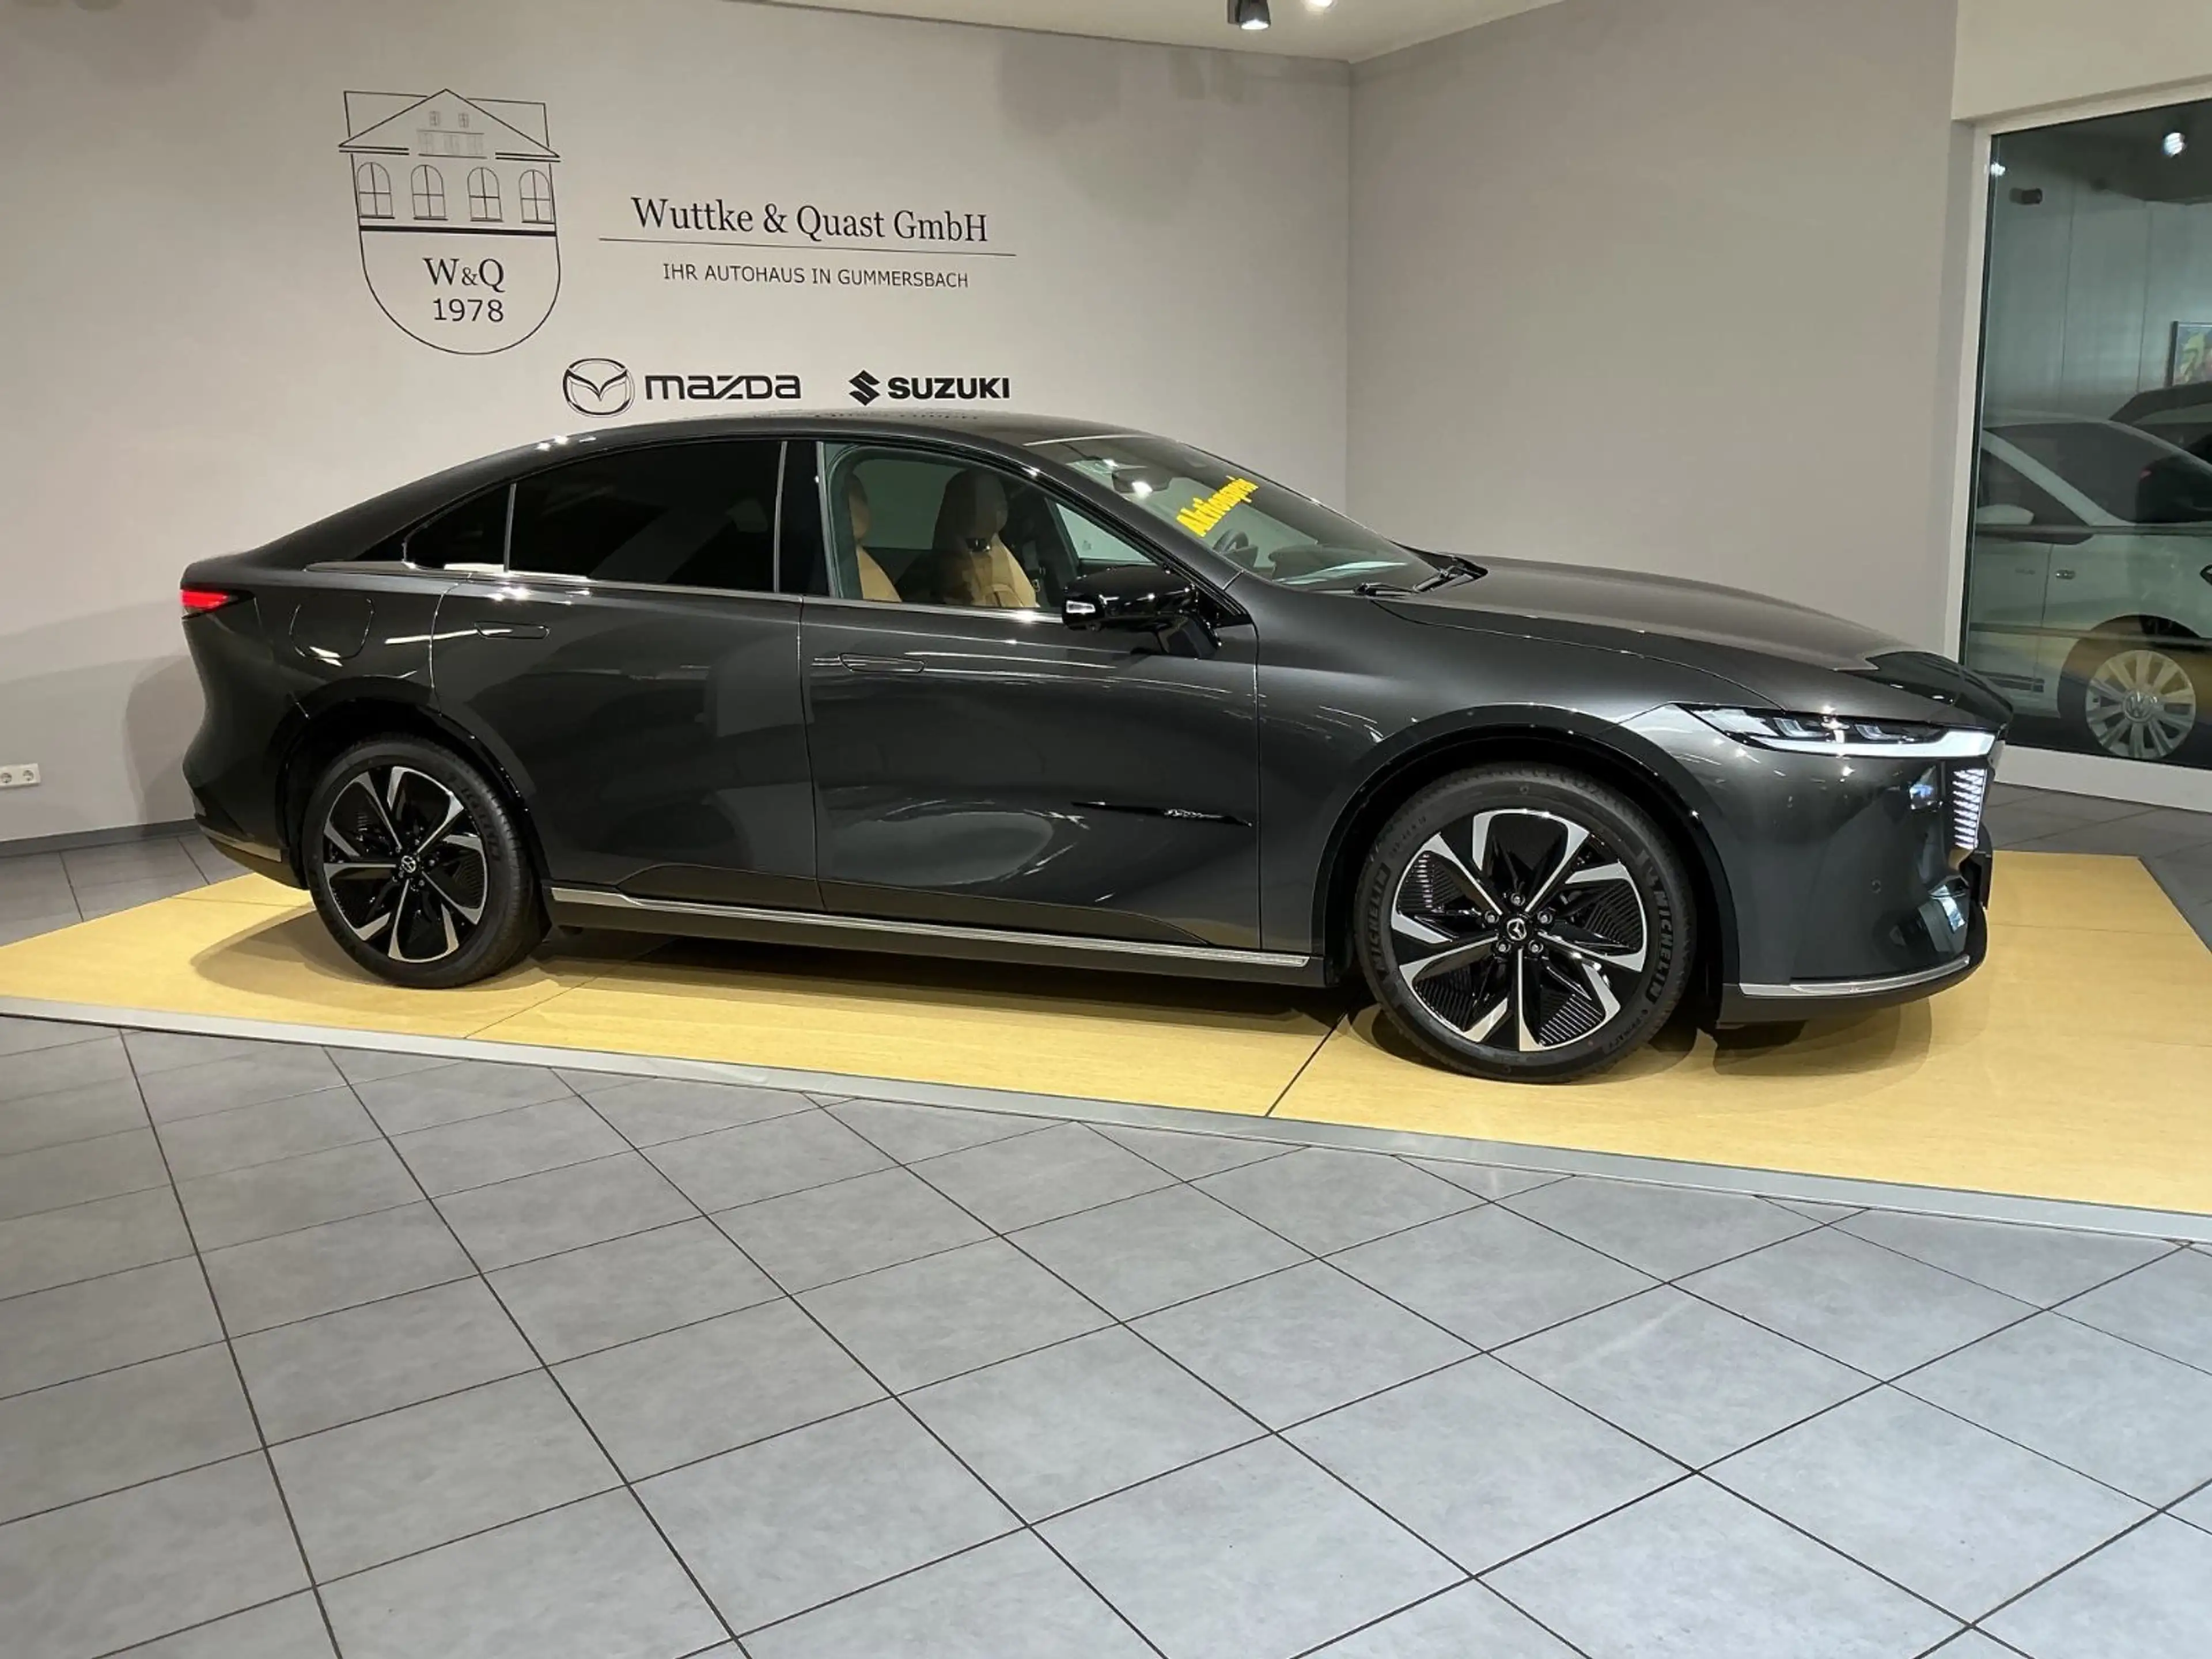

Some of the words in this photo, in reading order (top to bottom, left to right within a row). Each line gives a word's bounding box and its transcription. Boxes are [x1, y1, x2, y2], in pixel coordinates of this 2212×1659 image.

[630, 197, 753, 232] Wuttke
[763, 203, 789, 233] &
[797, 205, 885, 242] Quast
[894, 210, 988, 242] GmbH
[422, 257, 505, 293] W&Q
[664, 263, 699, 281] IHR
[705, 265, 805, 283] AUTOHAUS
[812, 268, 831, 284] IN
[838, 269, 968, 288] GUMMERSBACH
[433, 298, 504, 323] 1978
[888, 377, 1010, 399] SUZUKI
[1648, 891, 1673, 998] MICHELIN
